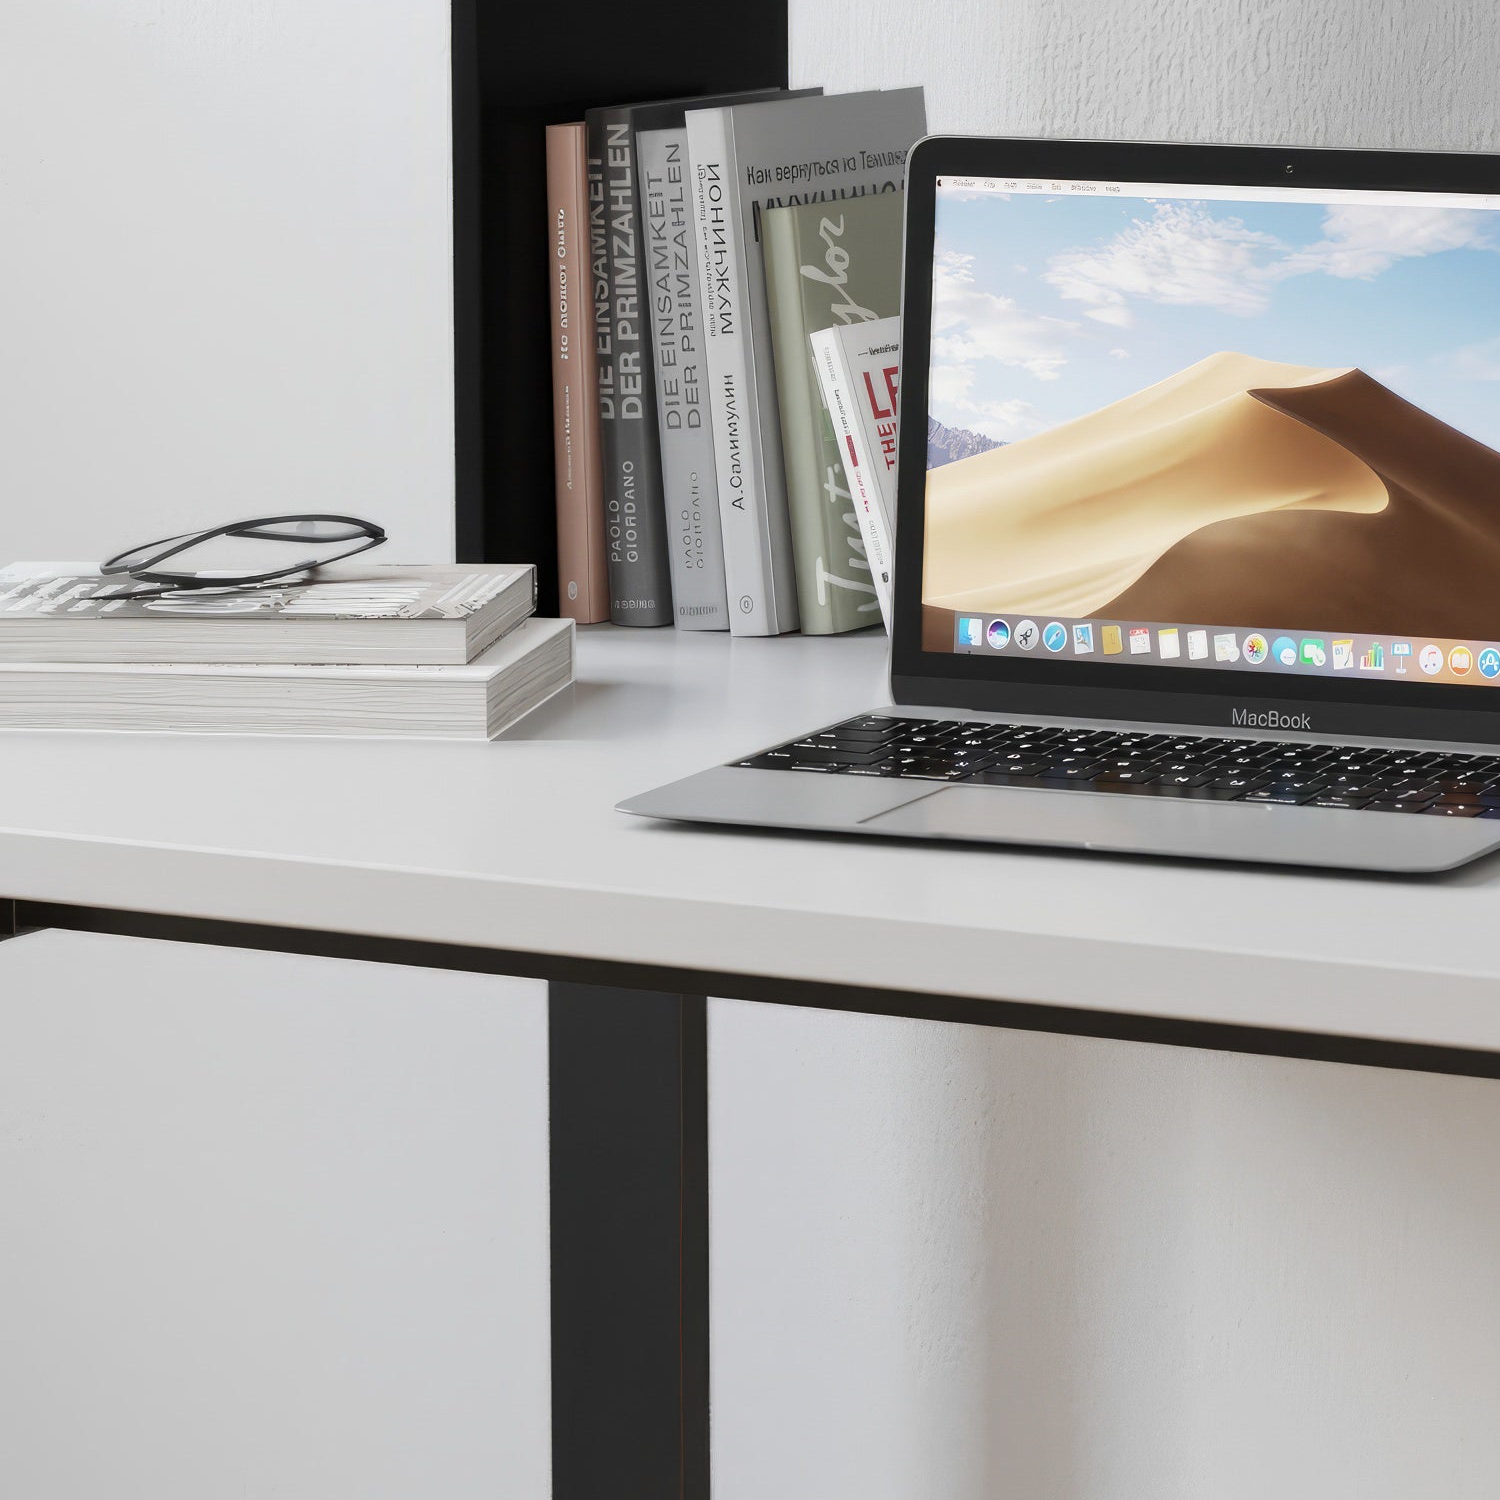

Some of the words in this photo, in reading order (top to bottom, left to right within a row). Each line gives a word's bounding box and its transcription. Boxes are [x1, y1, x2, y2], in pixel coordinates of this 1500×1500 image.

[606, 123, 640, 341] PRIMZAHLEN
[664, 143, 697, 352] PRIMZAHLEN
[646, 171, 678, 368] EINSAMKEIT
[599, 365, 615, 420] DIE
[619, 351, 643, 420] DER
[663, 378, 683, 430] DIE
[682, 365, 702, 430] DER
[608, 500, 622, 563] PAOLO
[1231, 707, 1312, 730] MacBook
